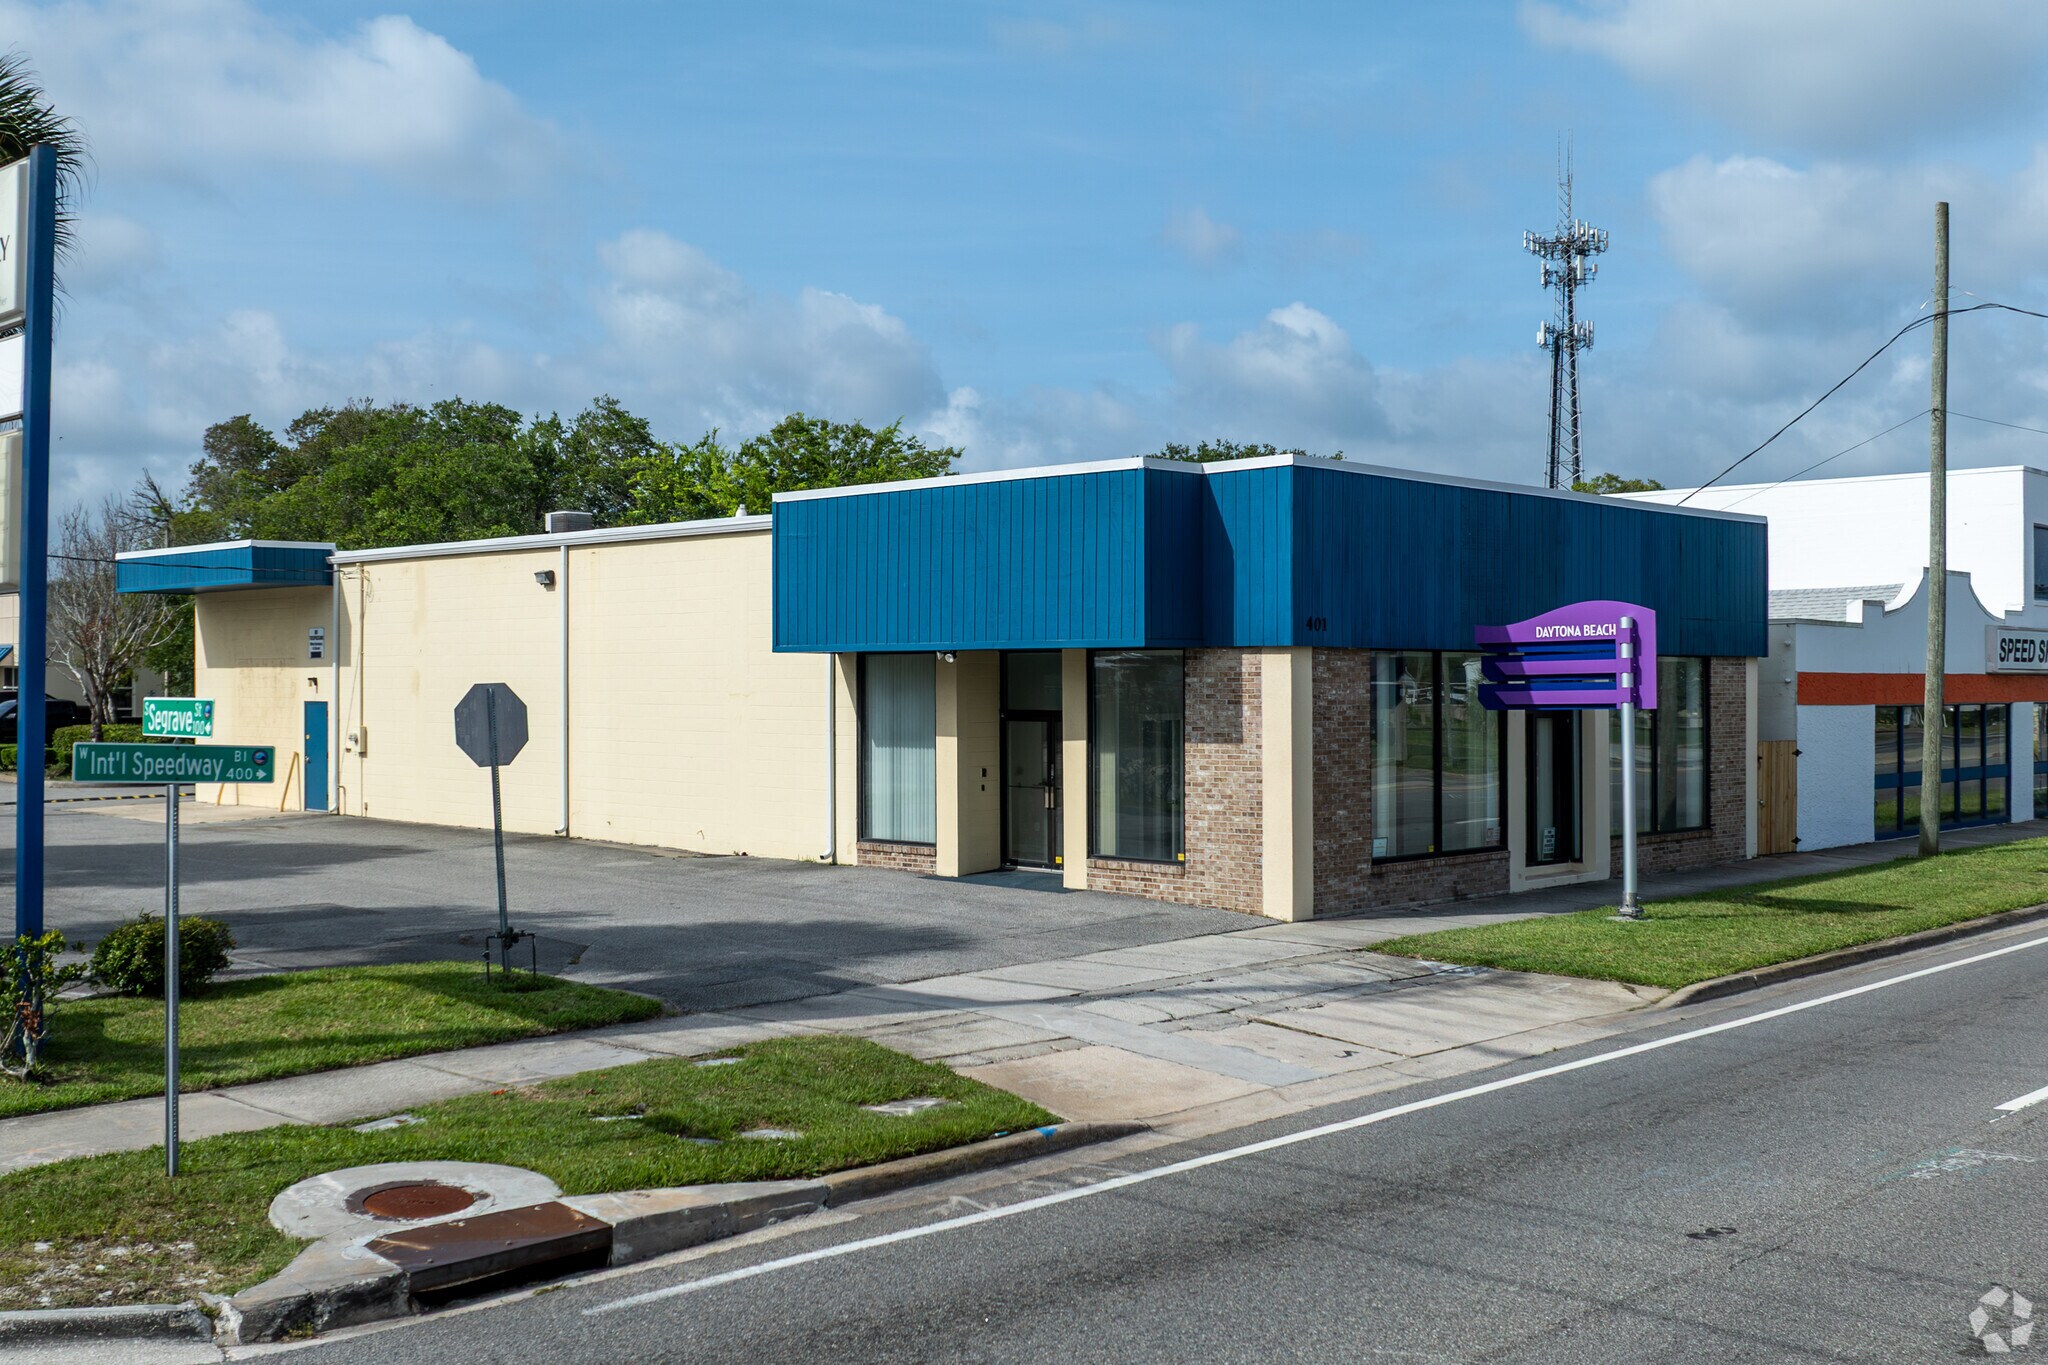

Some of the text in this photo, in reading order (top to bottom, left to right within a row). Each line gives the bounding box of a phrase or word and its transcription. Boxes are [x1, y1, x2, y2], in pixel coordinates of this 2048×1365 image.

[1306, 615, 1327, 632] 401
[1535, 623, 1617, 638] DAYTONA BEACH
[1999, 637, 2036, 663] SPEED
[144, 701, 202, 735] S Segrave St
[192, 720, 205, 735] 100
[79, 747, 88, 760] W
[91, 751, 126, 775] Int'l
[132, 751, 223, 782] Speedway
[225, 767, 253, 780] 400
